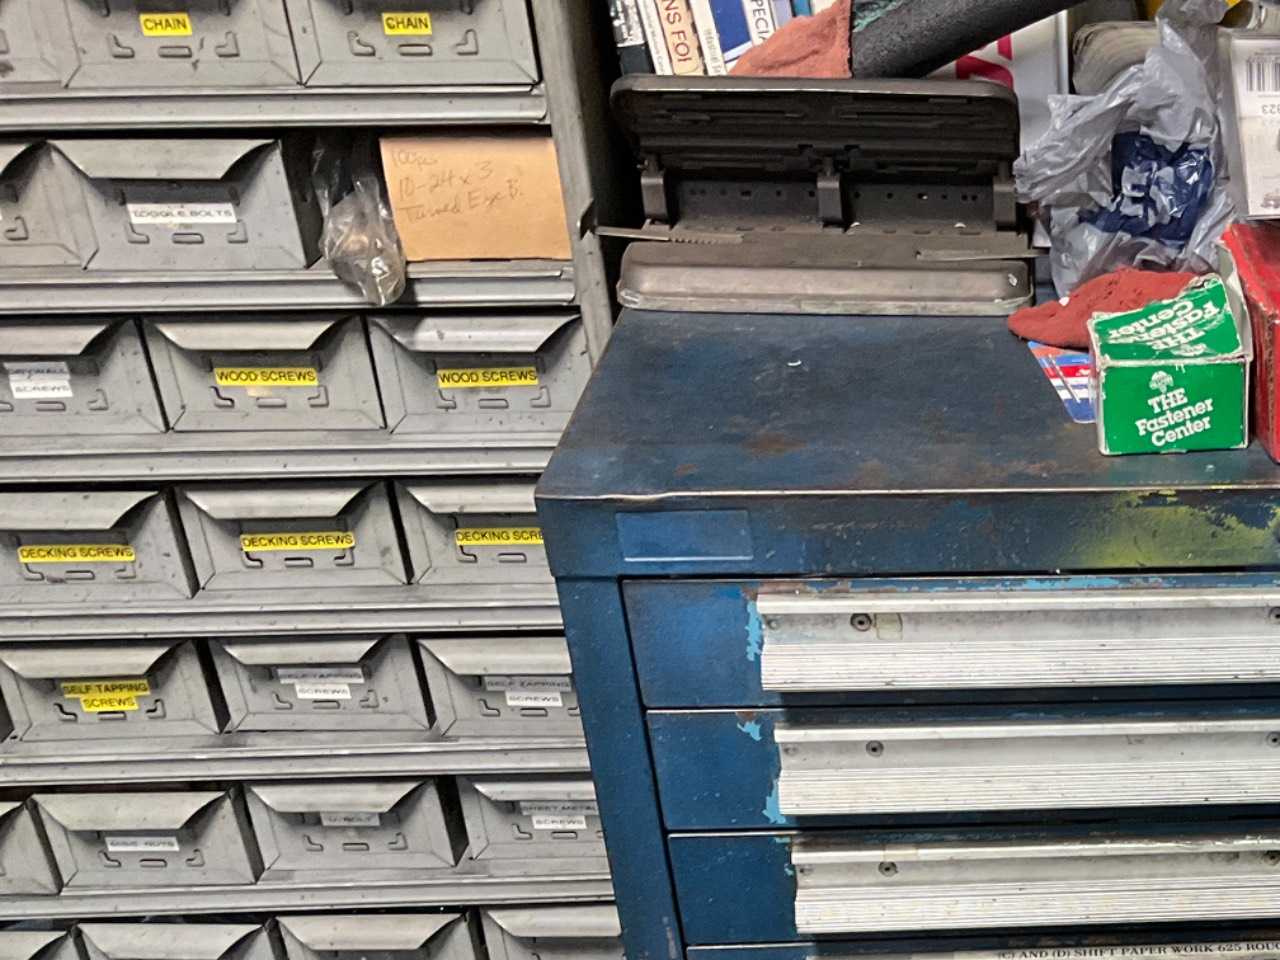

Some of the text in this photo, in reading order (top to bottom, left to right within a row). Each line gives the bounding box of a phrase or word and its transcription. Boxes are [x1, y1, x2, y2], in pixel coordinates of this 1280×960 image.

[143, 18, 188, 31] CHAIN
[385, 17, 429, 30] CHAIN
[190, 209, 233, 217] BOLTS
[217, 370, 316, 382] WOOD SCREWS
[438, 369, 537, 384] WOOD SCREWS
[1148, 388, 1188, 413] THE
[1135, 398, 1213, 436] Fastener
[1151, 416, 1211, 447] Center
[242, 533, 353, 547] DECKING SCREWS
[456, 531, 510, 541] DECKING
[20, 546, 133, 559] DECKING SCREWS
[64, 682, 148, 694] SELF TAPPING
[83, 697, 135, 708] SCREWS
[1020, 951, 1049, 959] AND
[1052, 950, 1071, 959] (D)
[1074, 949, 1115, 957] SHIFT
[1121, 947, 1167, 955] PAPER
[1171, 945, 1214, 954] WORK
[1217, 944, 1242, 952] 625
